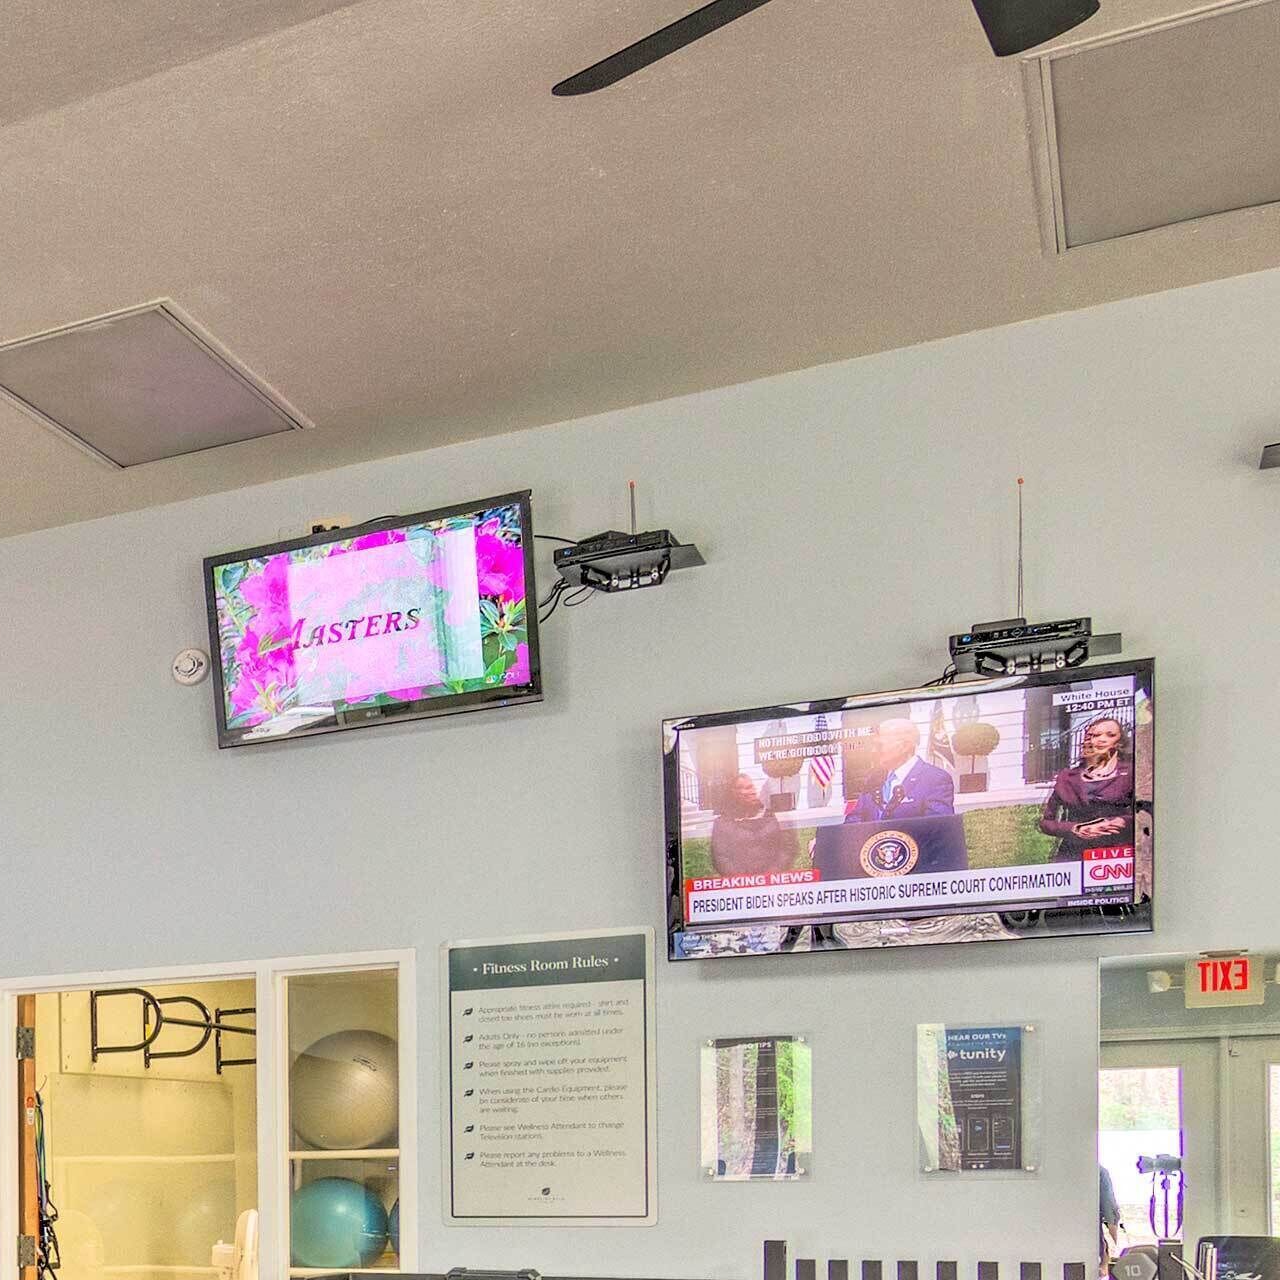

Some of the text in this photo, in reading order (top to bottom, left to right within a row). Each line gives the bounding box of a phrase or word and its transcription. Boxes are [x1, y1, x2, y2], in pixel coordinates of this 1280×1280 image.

[291, 608, 422, 650] MASTERS
[1061, 687, 1130, 702] White House
[1066, 698, 1130, 712] 12:40 PM ET
[758, 735, 798, 747] NOTHING
[1091, 847, 1132, 859] LIVE
[1090, 862, 1133, 880] CNN
[693, 870, 813, 891] BREAKING NEWS
[693, 896, 744, 913] PRESIDENT
[746, 893, 775, 908] BIDEN
[777, 890, 814, 907] SPEAKS
[816, 888, 848, 904] AFTER
[849, 885, 896, 902] HISTORIC
[898, 880, 947, 900] SUPREME
[950, 876, 987, 894] COURT
[988, 871, 1072, 892] CONFIRMATION
[1095, 896, 1130, 905] POLITICS
[482, 955, 609, 976] Fitness Room Rules
[947, 1032, 1007, 1041] HEAR OUR TVs
[959, 1047, 1007, 1062] tunity
[1124, 1264, 1141, 1277] 10
